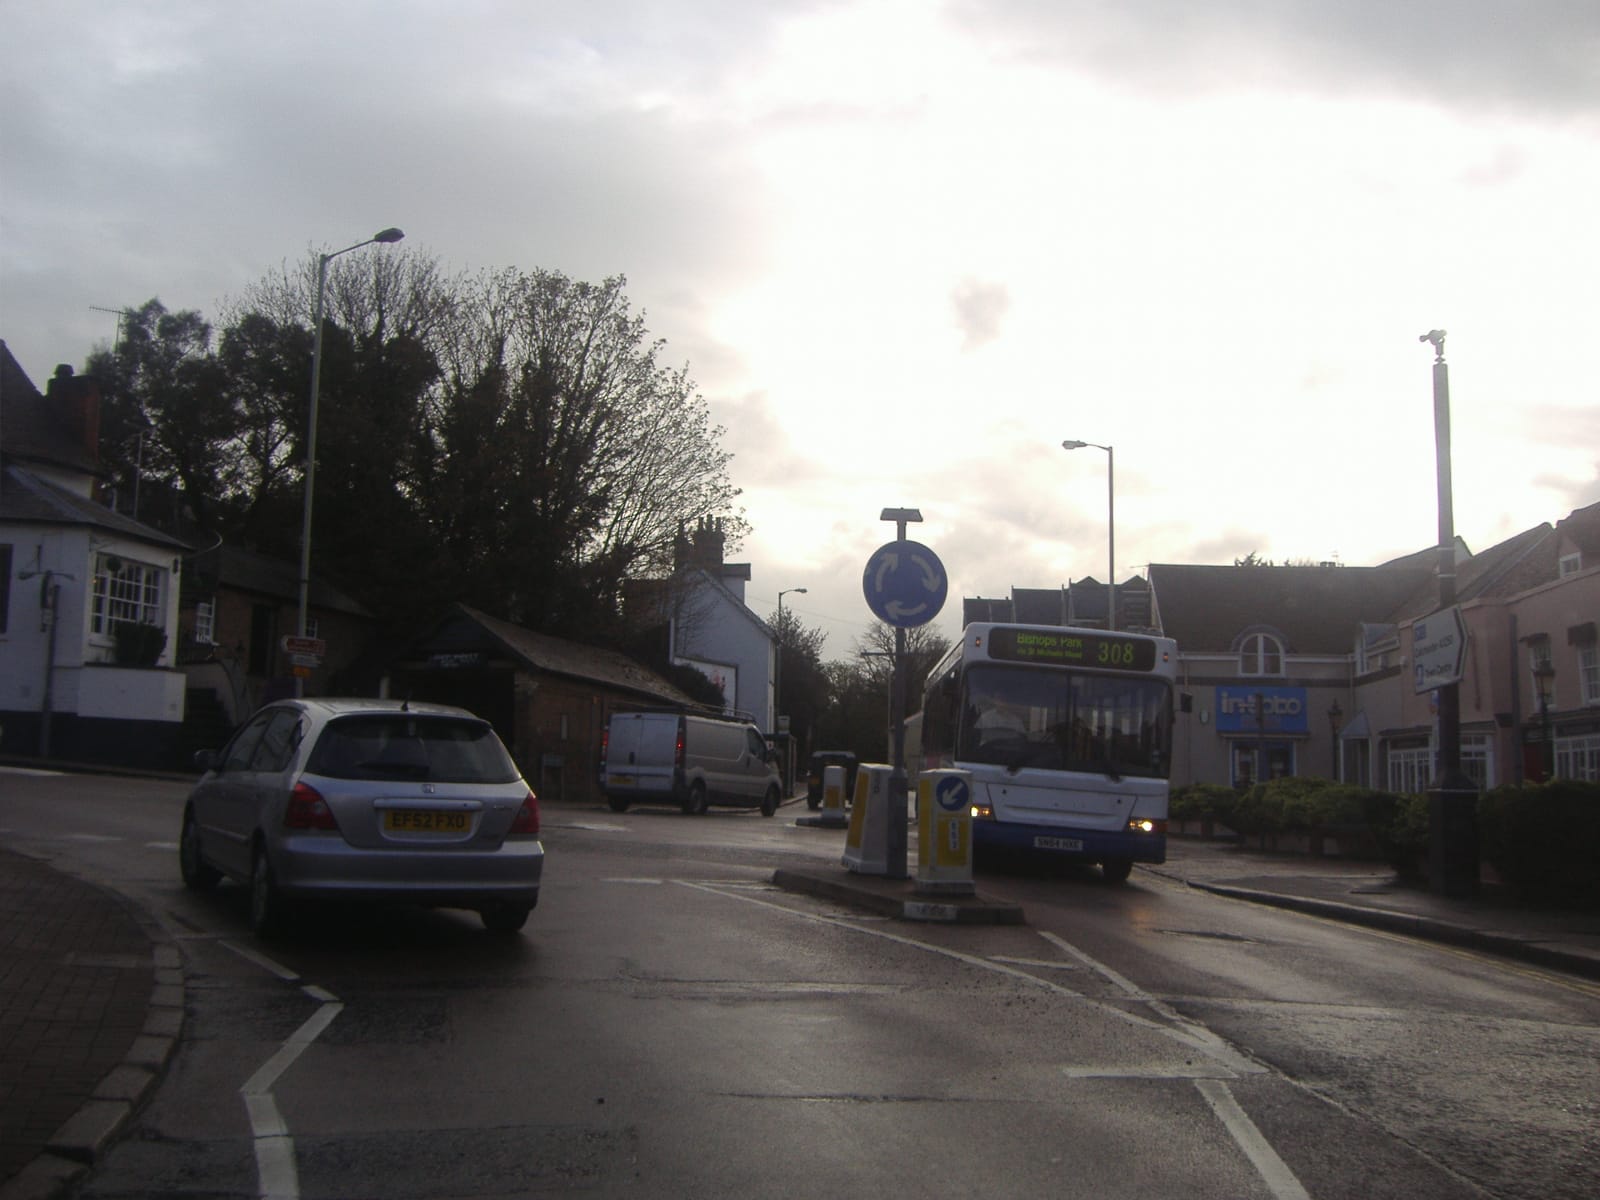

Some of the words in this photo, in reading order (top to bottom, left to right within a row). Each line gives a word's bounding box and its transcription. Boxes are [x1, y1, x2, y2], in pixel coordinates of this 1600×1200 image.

[1017, 633, 1057, 647] Bishops
[1060, 636, 1082, 648] Park
[1098, 641, 1134, 664] 308
[391, 813, 431, 827] EF52
